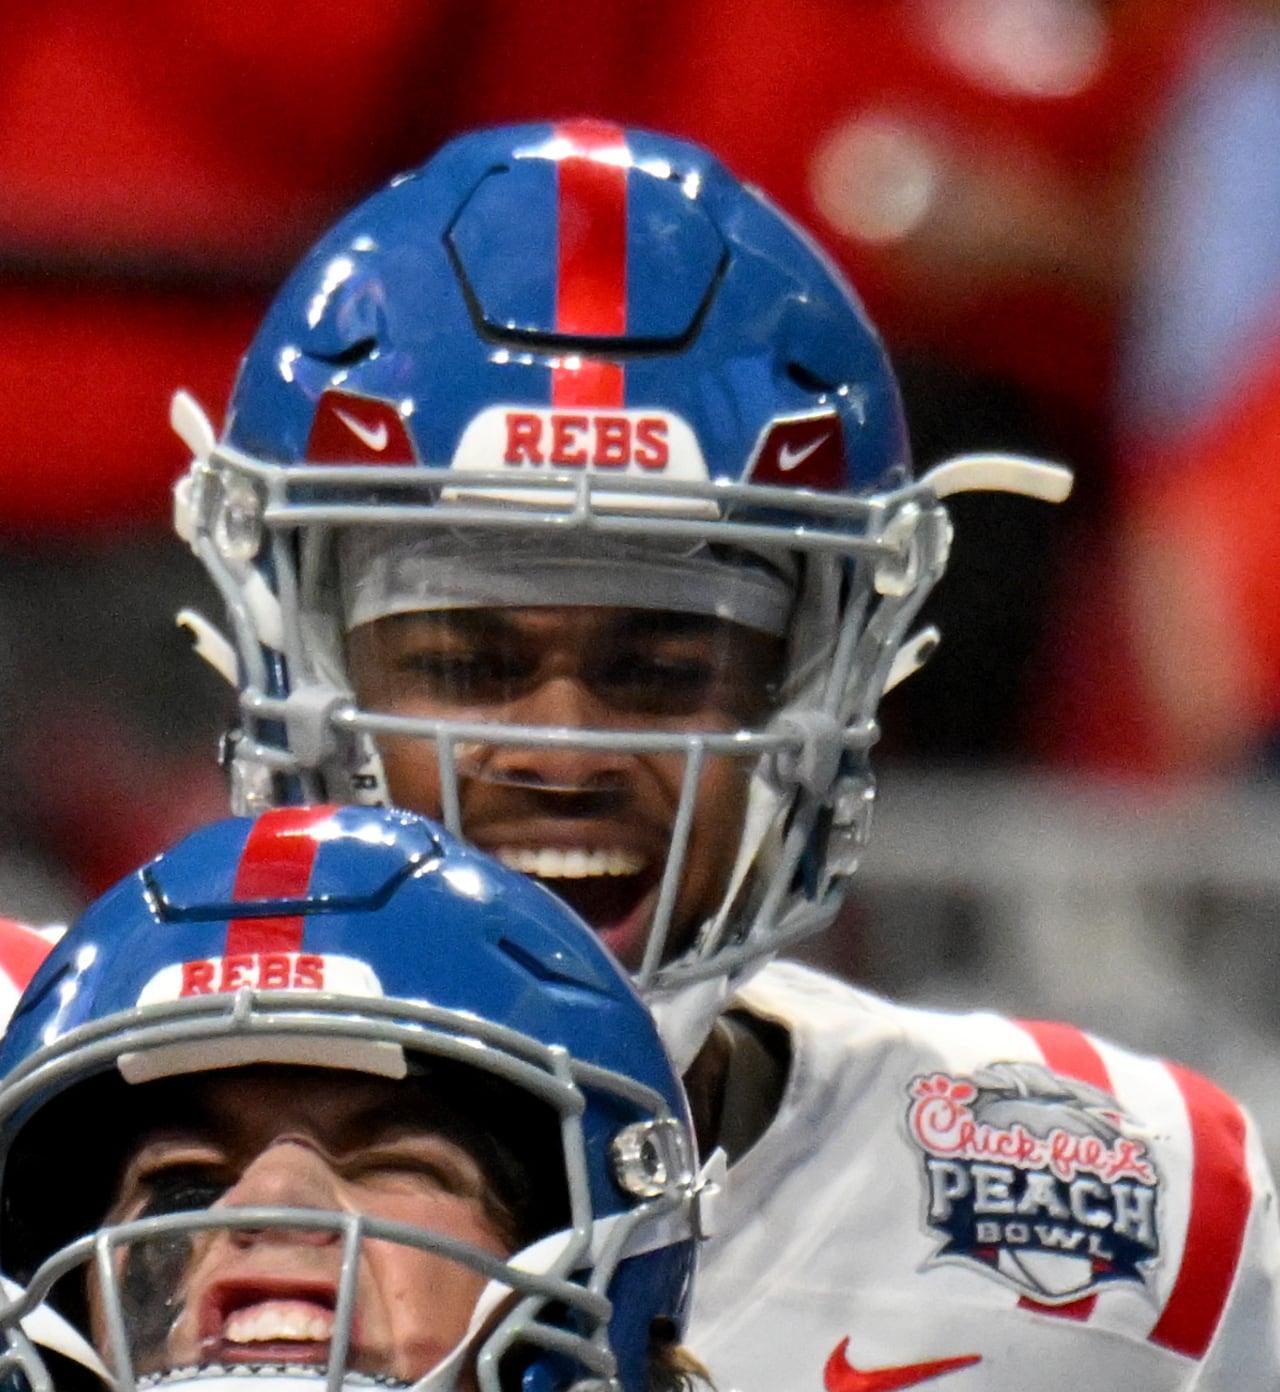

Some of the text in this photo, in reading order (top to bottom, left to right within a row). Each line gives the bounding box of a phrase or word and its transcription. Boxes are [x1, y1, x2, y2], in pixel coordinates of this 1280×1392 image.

[503, 412, 670, 471] REBS
[179, 953, 326, 998] REBS
[913, 1074, 1153, 1181] Chick-fil-A
[927, 1159, 1156, 1246] PEACH
[975, 1220, 1114, 1260] BOWL
